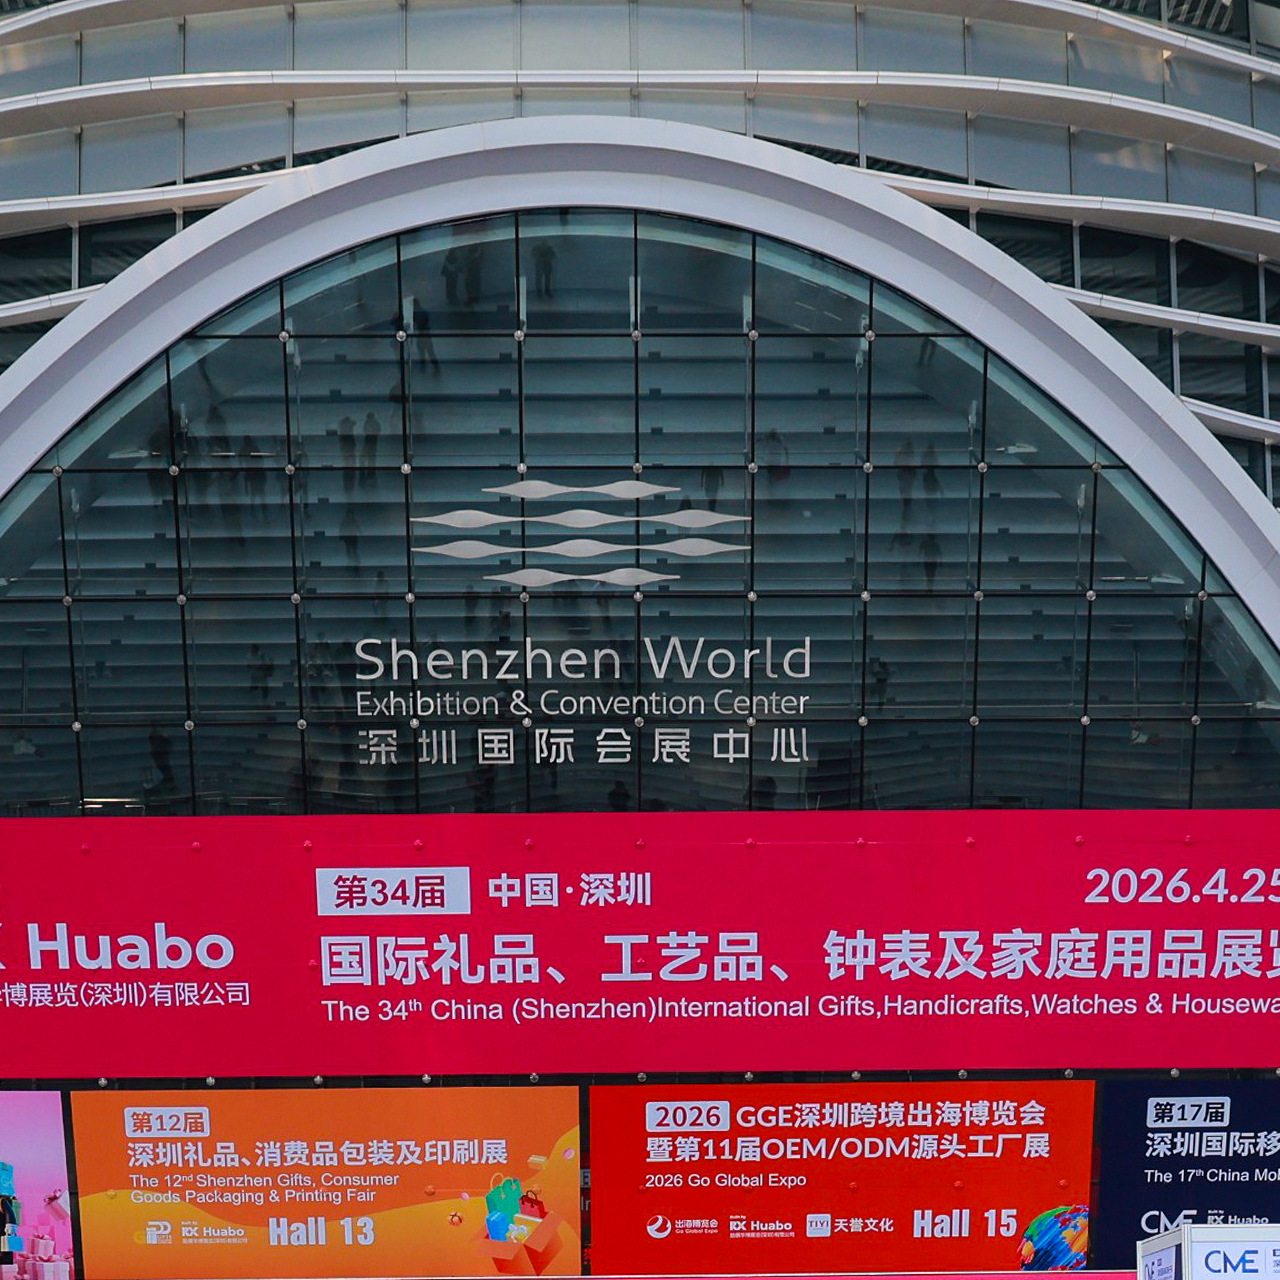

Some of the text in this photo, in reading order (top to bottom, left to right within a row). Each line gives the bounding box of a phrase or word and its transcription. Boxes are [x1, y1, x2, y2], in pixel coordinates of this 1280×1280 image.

[354, 636, 811, 680] Shenzhen World
[356, 688, 809, 716] Exhibition & Convention Center
[358, 727, 809, 765] 深圳国际会展中心
[333, 874, 446, 909] 第34届
[27, 921, 235, 970] Huabo
[321, 1000, 371, 1021] The
[377, 998, 422, 1021] 34th
[430, 998, 503, 1020] China
[1146, 994, 1163, 1015] &
[131, 1112, 206, 1134] 第12届
[655, 1100, 1047, 1129] 2026 GGE深圳跨境出海博览会
[1153, 1101, 1226, 1124] 第17届
[127, 1139, 508, 1168] 深圳礼品、消费品包装及印刷展
[645, 1133, 1051, 1163] 暨第11届OEM/ODM源头工厂展
[130, 1172, 400, 1189] The 12nd Shenzhen Gifts, Consumer
[645, 1173, 807, 1190] 2026 Go Global Expo
[1144, 1169, 1172, 1182] The
[1177, 1169, 1204, 1182] 17th
[1206, 1168, 1250, 1182] China
[130, 1188, 377, 1206] Goods Packaging & Printing Fair
[203, 1226, 245, 1237] Huabo
[268, 1217, 375, 1246] Hall 13
[751, 1220, 792, 1231] Huabo
[834, 1218, 894, 1233] 天誉文化
[913, 1209, 1018, 1238] Hall 15
[1228, 1214, 1269, 1224] Huabo
[1204, 1250, 1259, 1274] CME
